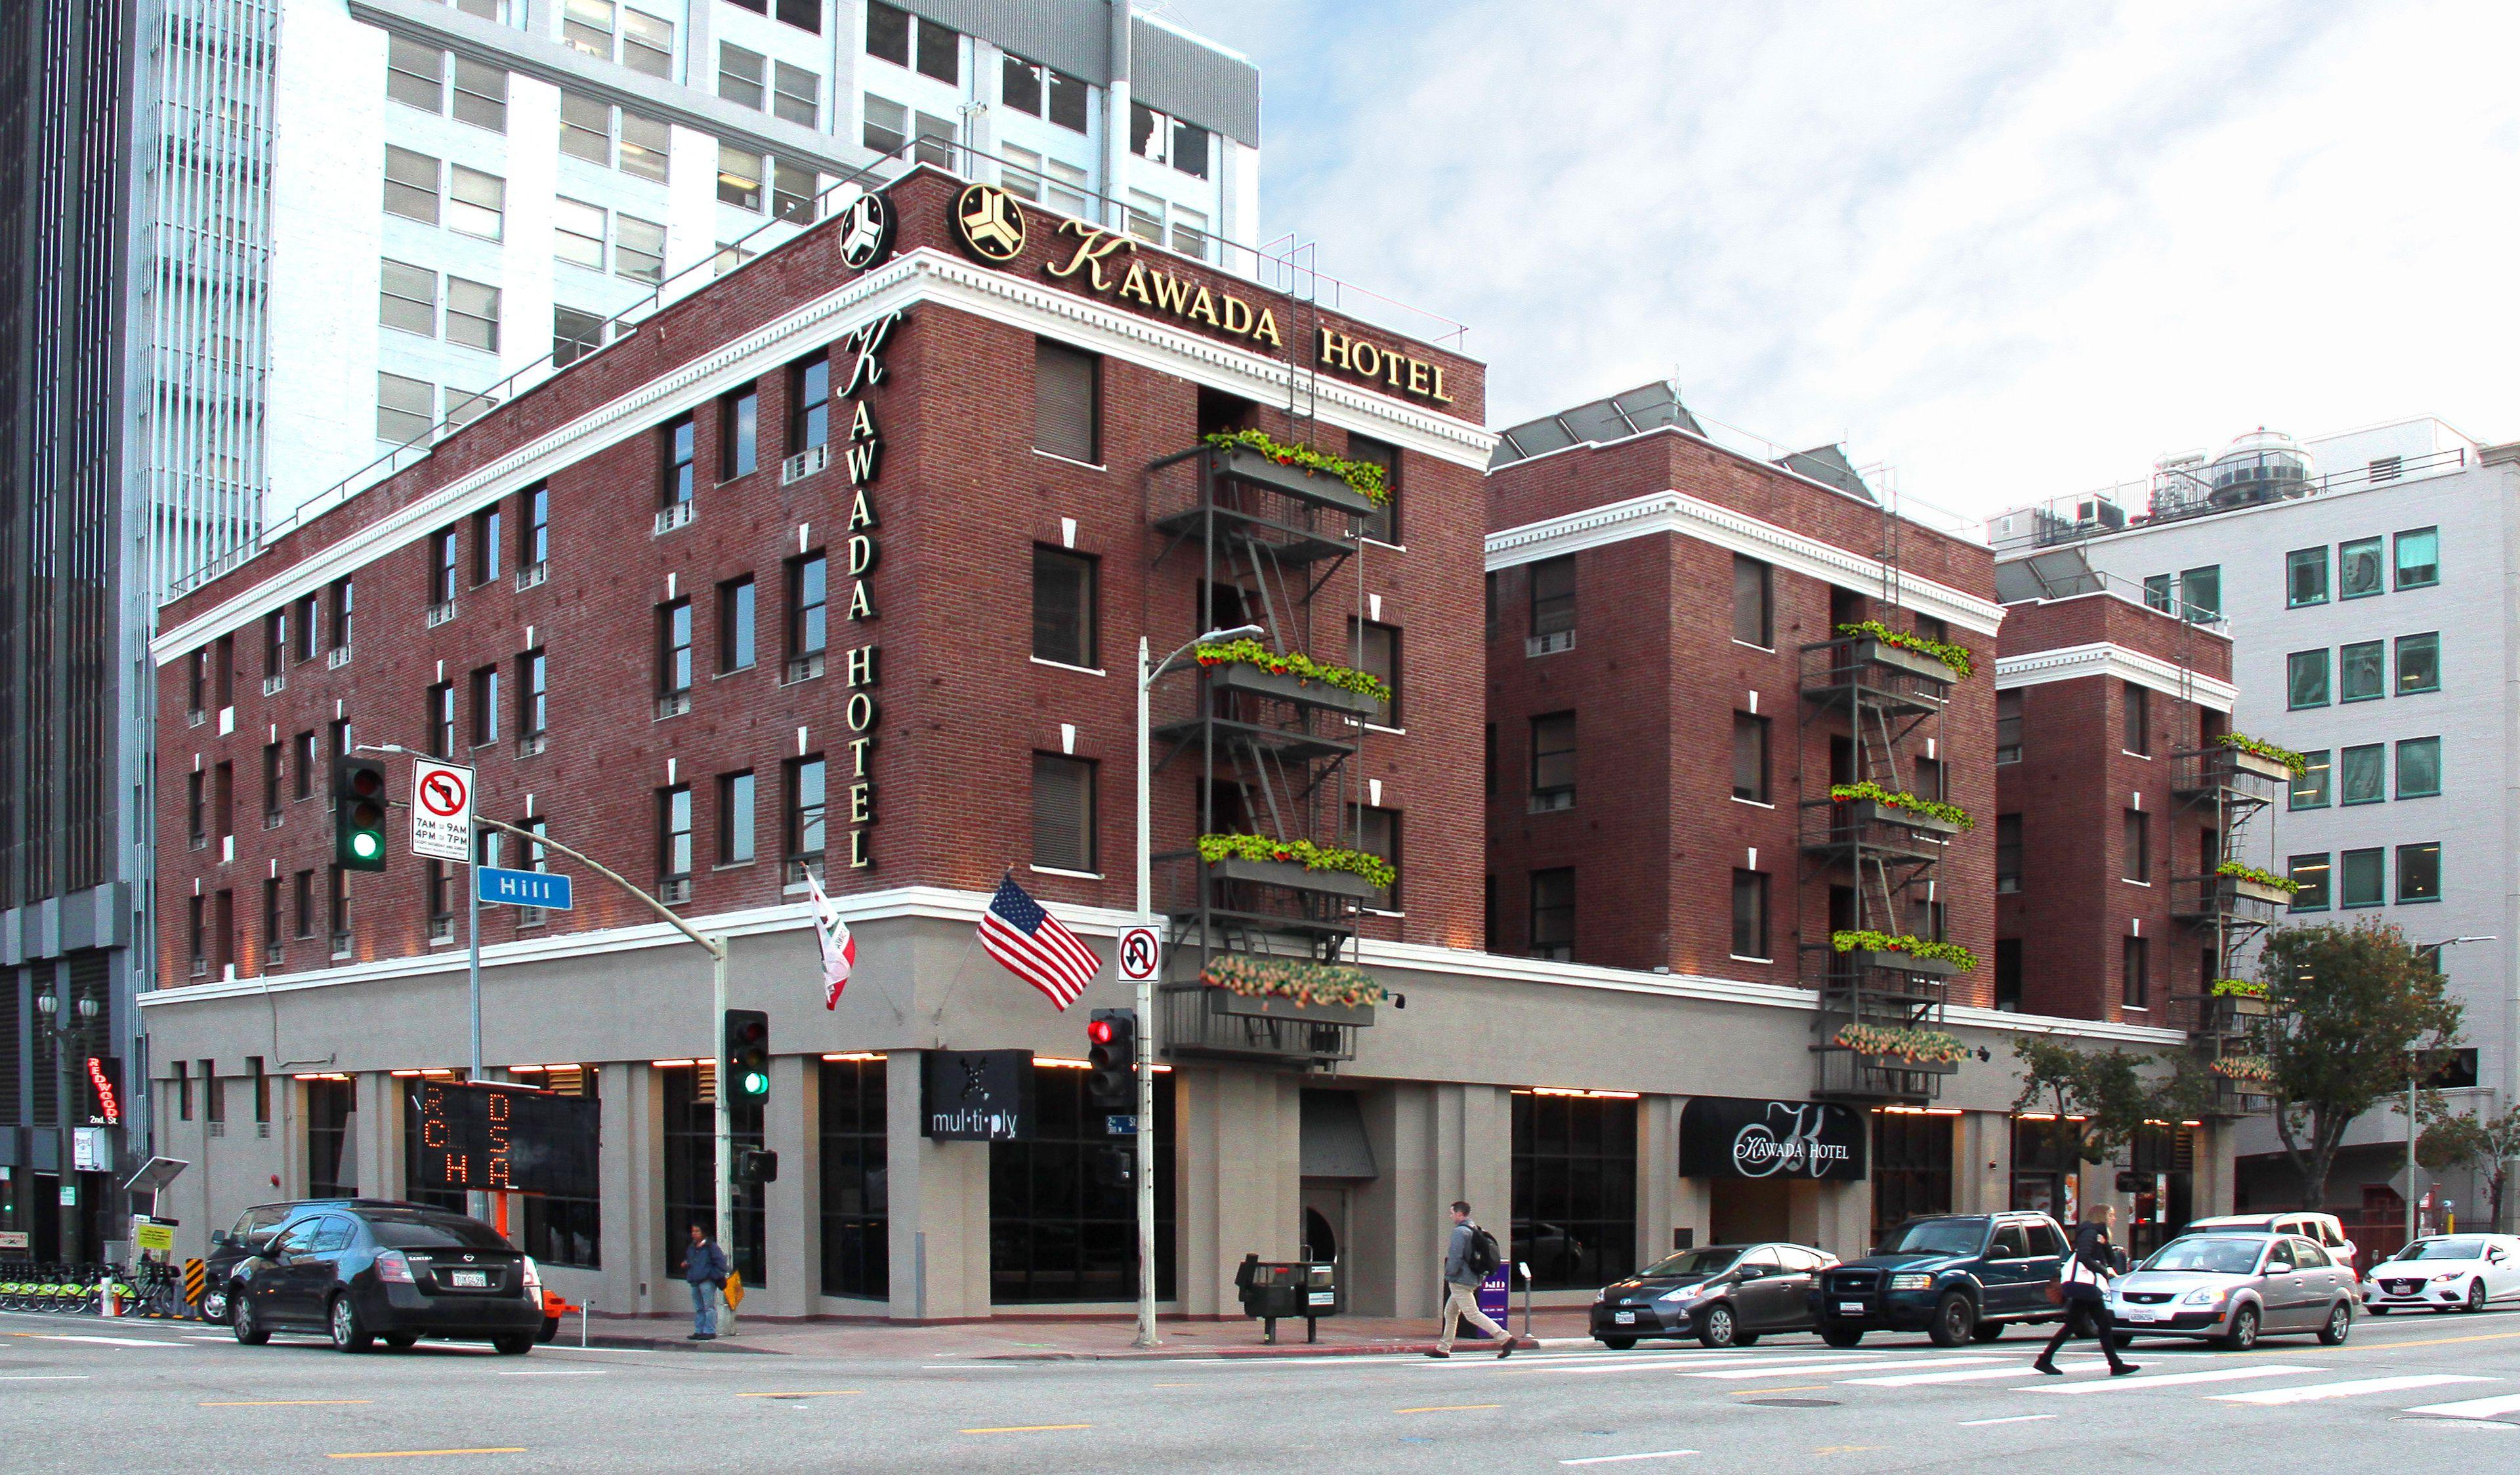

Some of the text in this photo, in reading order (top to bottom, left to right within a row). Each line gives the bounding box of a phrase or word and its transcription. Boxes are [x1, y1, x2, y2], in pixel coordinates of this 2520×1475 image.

[1046, 218, 1454, 404] KAWADA HOTEL
[837, 310, 901, 869] KAWADA HOTEL
[415, 829, 436, 840] 4PM
[447, 834, 467, 845] 7PM
[416, 817, 436, 829] 7AM
[447, 823, 467, 834] 9AM
[500, 877, 549, 899] Hill
[89, 1058, 118, 1117] REDWOOD
[1733, 1136, 1849, 1159] KAWADA HOTEL
